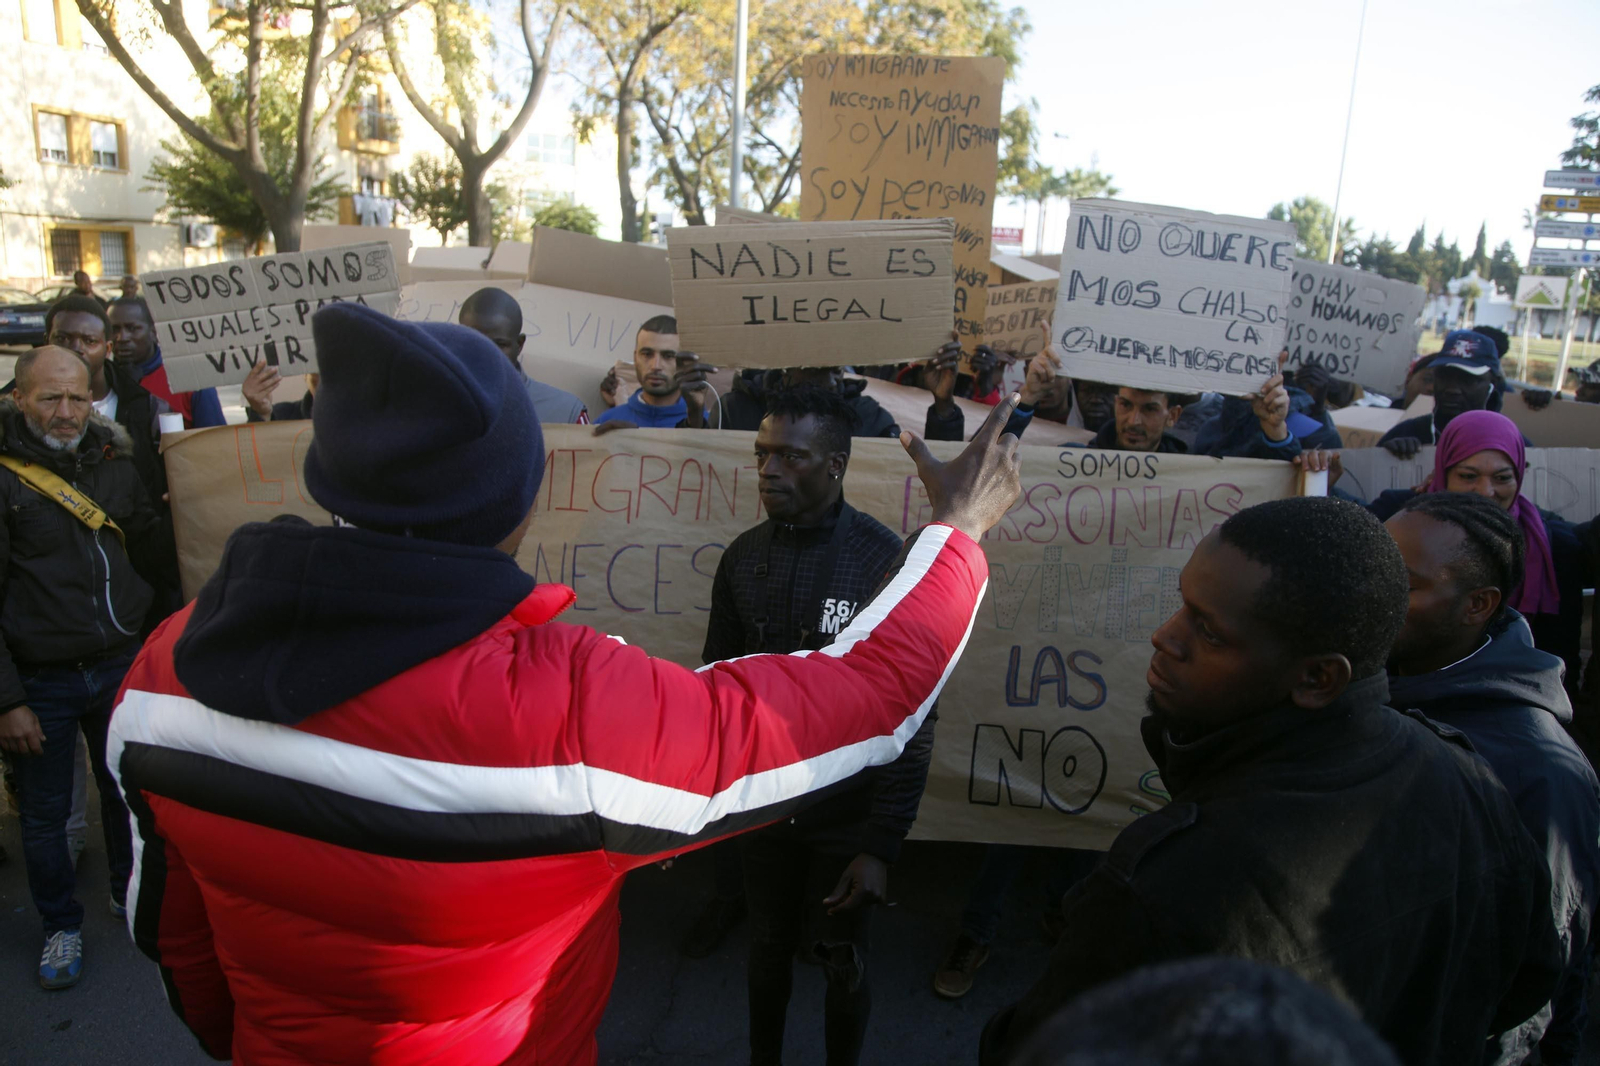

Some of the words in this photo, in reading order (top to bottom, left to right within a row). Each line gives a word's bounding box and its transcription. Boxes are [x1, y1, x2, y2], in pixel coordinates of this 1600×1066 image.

[1076, 214, 1141, 254] NO
[146, 266, 246, 304] TODOS
[262, 251, 388, 291] SOMOS
[886, 248, 936, 276] ES
[1067, 270, 1161, 308] MOS
[1320, 276, 1356, 303] HAY
[742, 295, 902, 325] ILEGAL
[1311, 295, 1404, 334] HUMANOS
[1283, 346, 1360, 377] ANOS!
[1058, 451, 1159, 481] SOMOS
[902, 475, 1244, 548] PRSONAS
[1006, 645, 1107, 711] LAS
[969, 723, 1108, 814] NO
